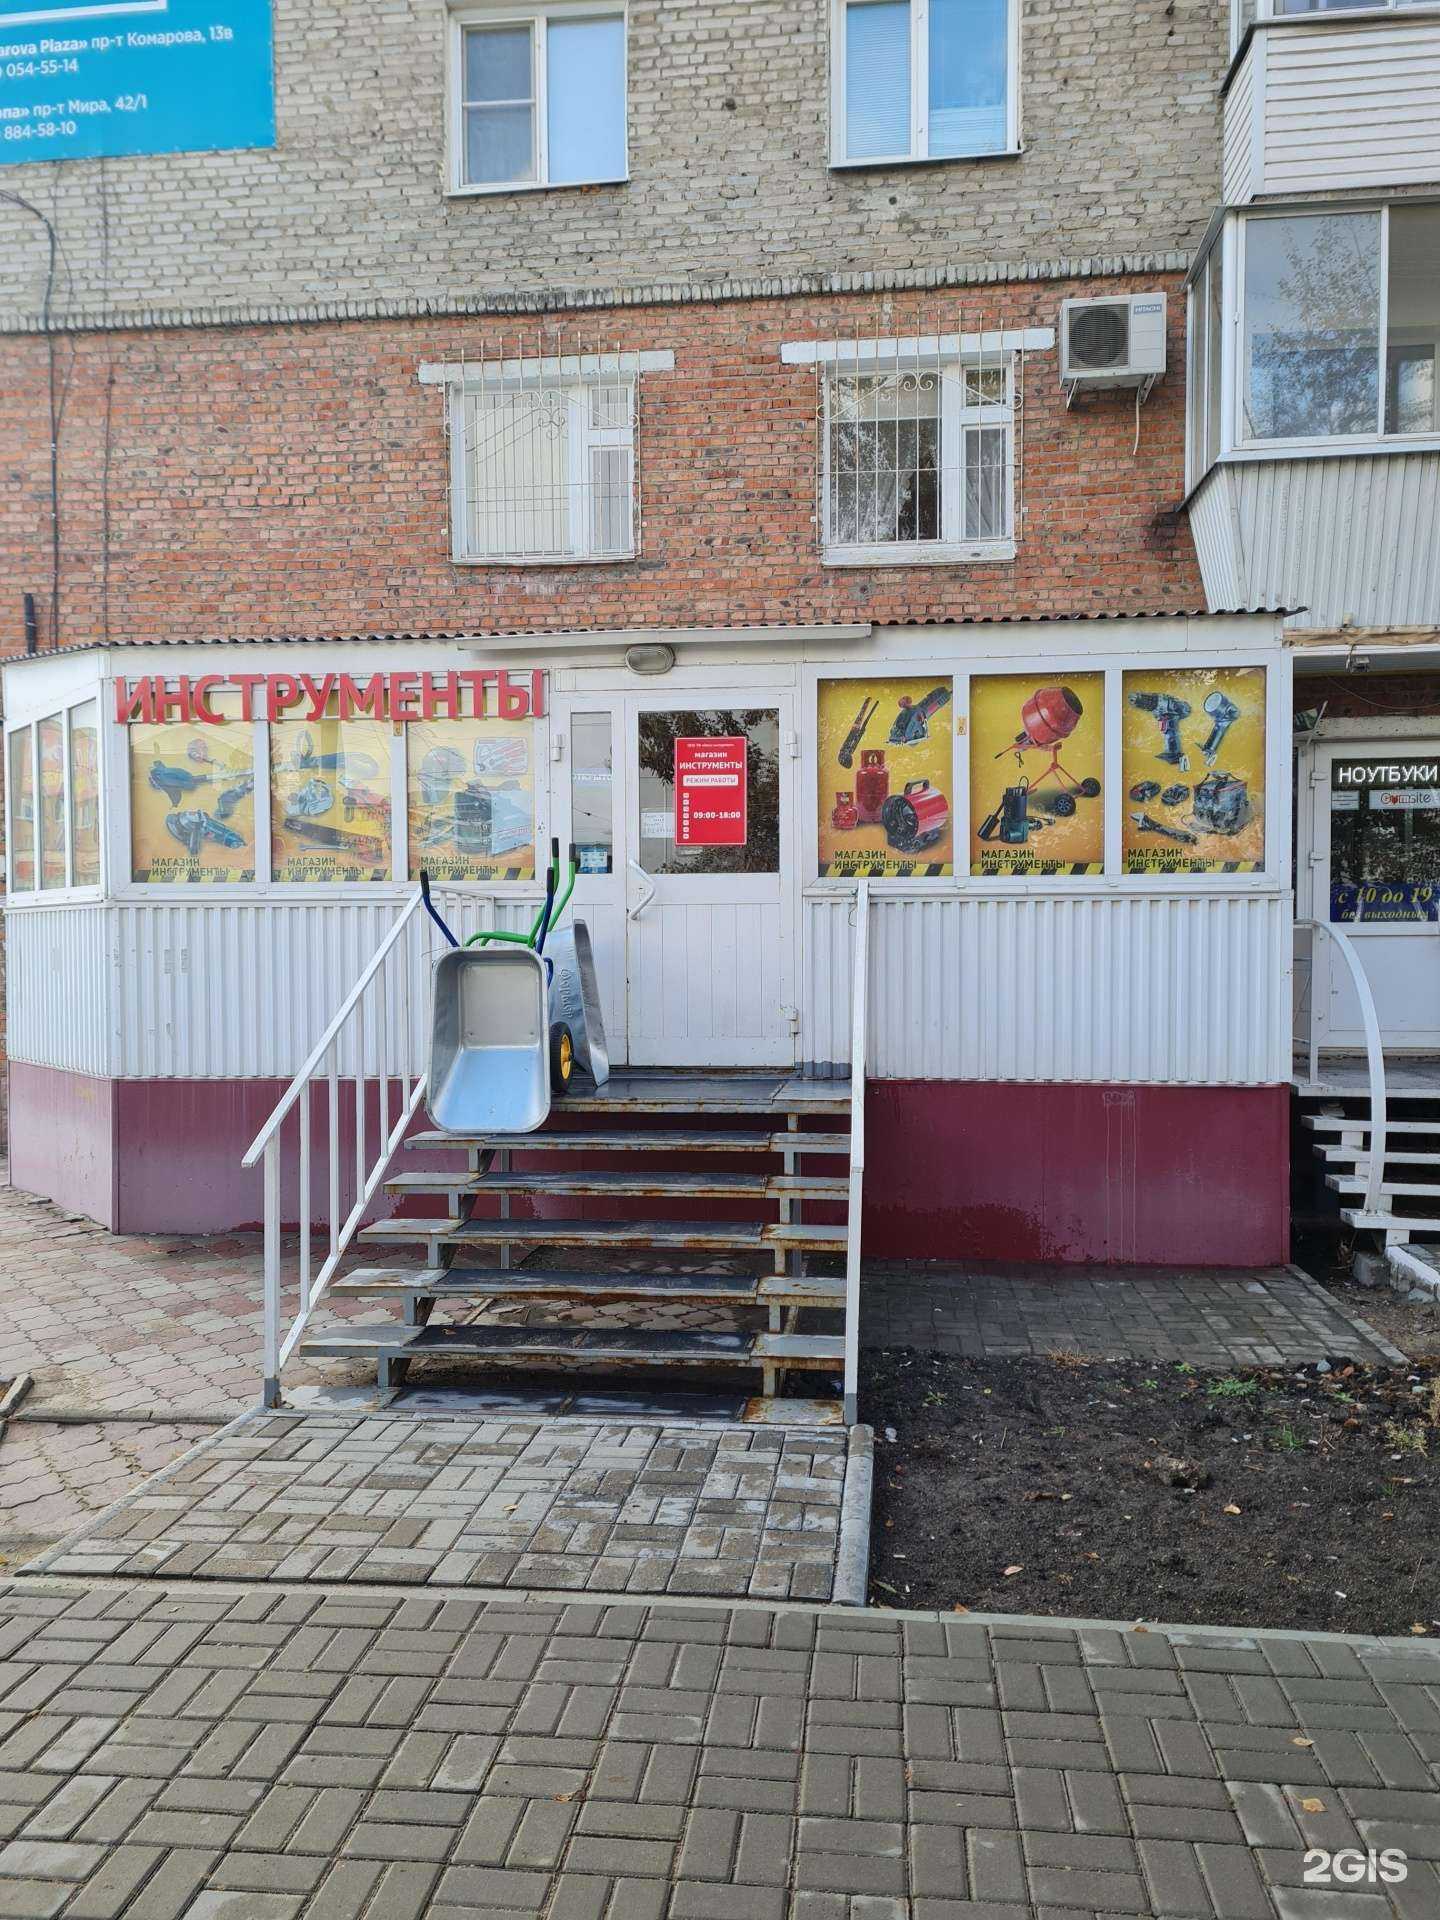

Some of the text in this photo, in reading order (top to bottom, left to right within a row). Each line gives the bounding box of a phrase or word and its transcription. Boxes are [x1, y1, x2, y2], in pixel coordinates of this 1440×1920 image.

[41, 37, 87, 54] Plaza»
[92, 34, 123, 51] пр-т
[127, 29, 206, 47] Комарова,
[209, 26, 233, 41] 13в
[7, 58, 78, 77] 054-55-14
[33, 103, 64, 120] пр-т
[68, 99, 111, 116] Мира,
[115, 94, 148, 110] 42/1
[4, 120, 76, 140] 884-58-10
[115, 669, 546, 724] ИНСТРУМЕНТЫ
[680, 761, 743, 770] ИНСТРУМЕНТЫ
[1339, 765, 1438, 783] НОУТБУКИ
[834, 850, 886, 859] МАГАЗИН
[981, 849, 1035, 858] МАГАЗИН
[1128, 848, 1183, 857] МАГАЗИН
[152, 857, 200, 866] МАГАЗИН
[287, 856, 336, 866] МАГАЗИН
[420, 856, 470, 865] МАГАЗИН
[834, 859, 918, 870] ИНСТРУМЕНТЫ
[980, 858, 1066, 869] ИНСТРУМЕНТЫ
[1127, 857, 1216, 868] ИНСТРУМЕНТЫ
[152, 866, 230, 876] ИНСТРУМЕНТЫ
[287, 866, 365, 876] ИНСТРУМЕНТЫ
[1381, 887, 1404, 903] до
[1410, 886, 1433, 903] 19
